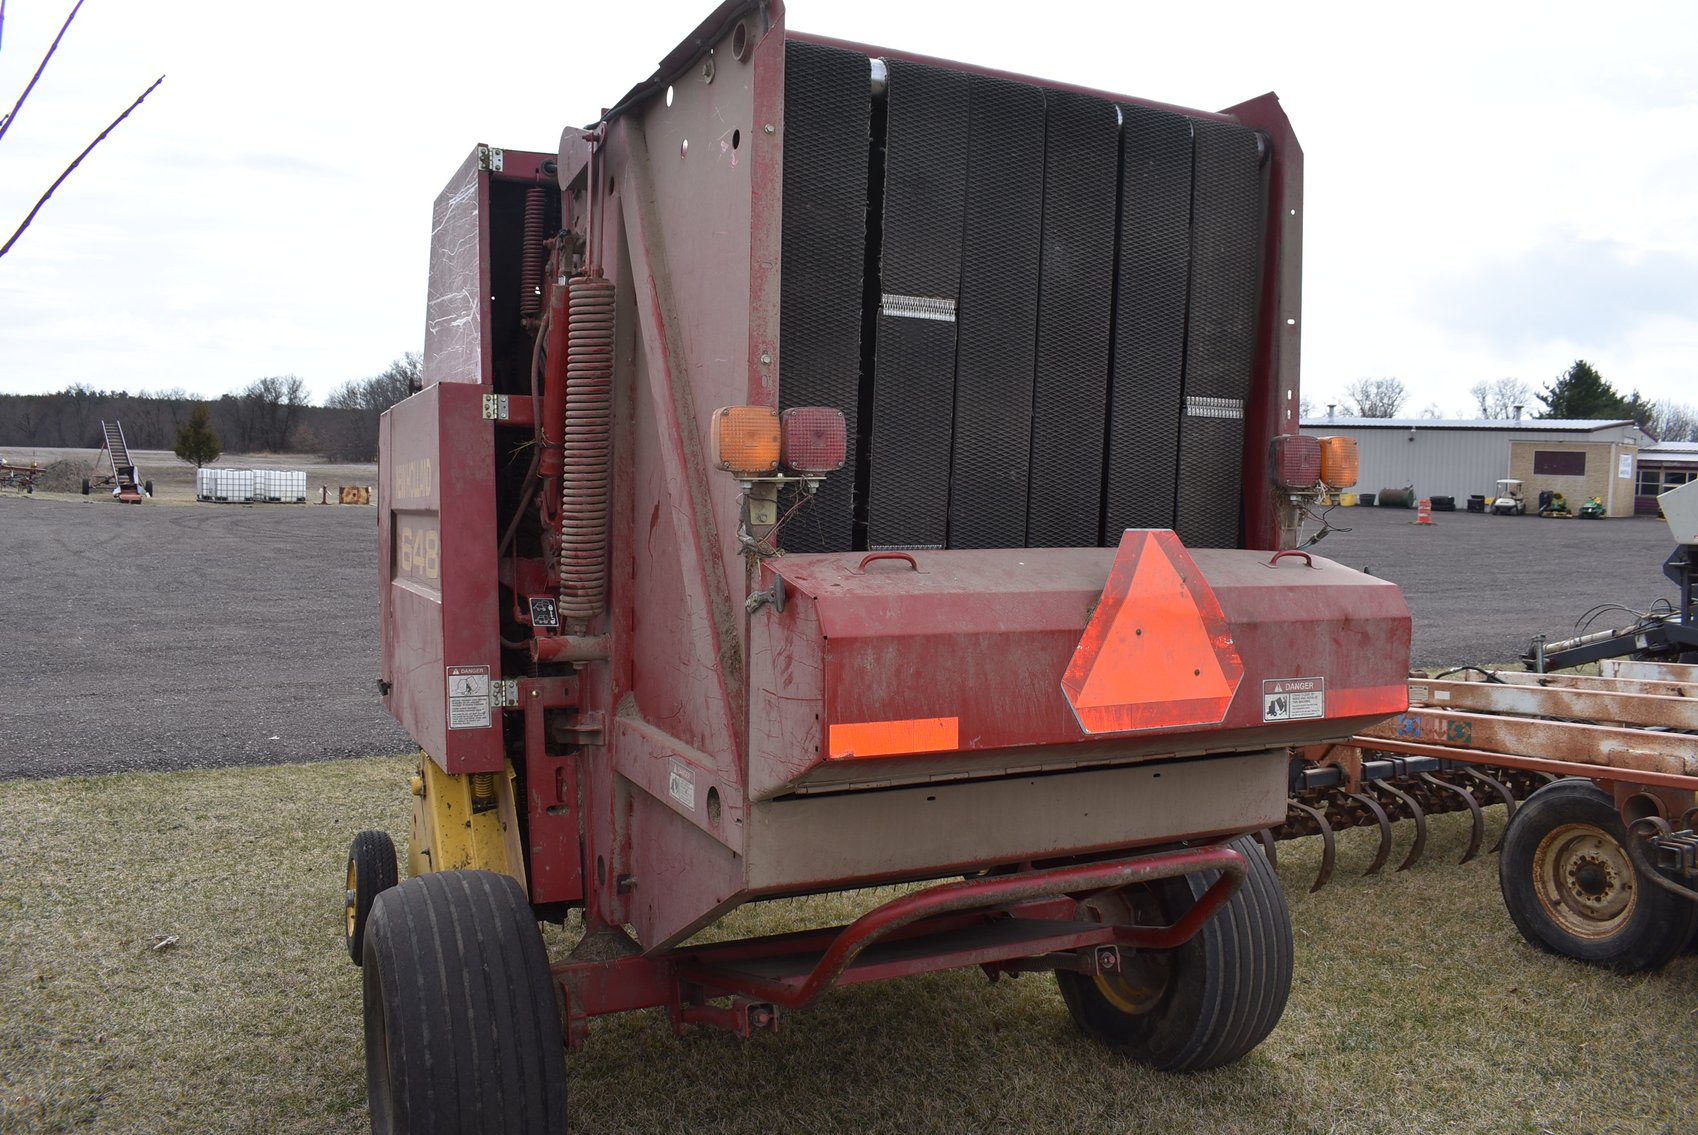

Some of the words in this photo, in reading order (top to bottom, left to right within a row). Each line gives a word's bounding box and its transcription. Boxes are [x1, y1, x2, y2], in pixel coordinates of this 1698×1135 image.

[406, 458, 432, 497] HOLLAND
[402, 527, 438, 579] 648
[1285, 682, 1314, 691] DANGER
